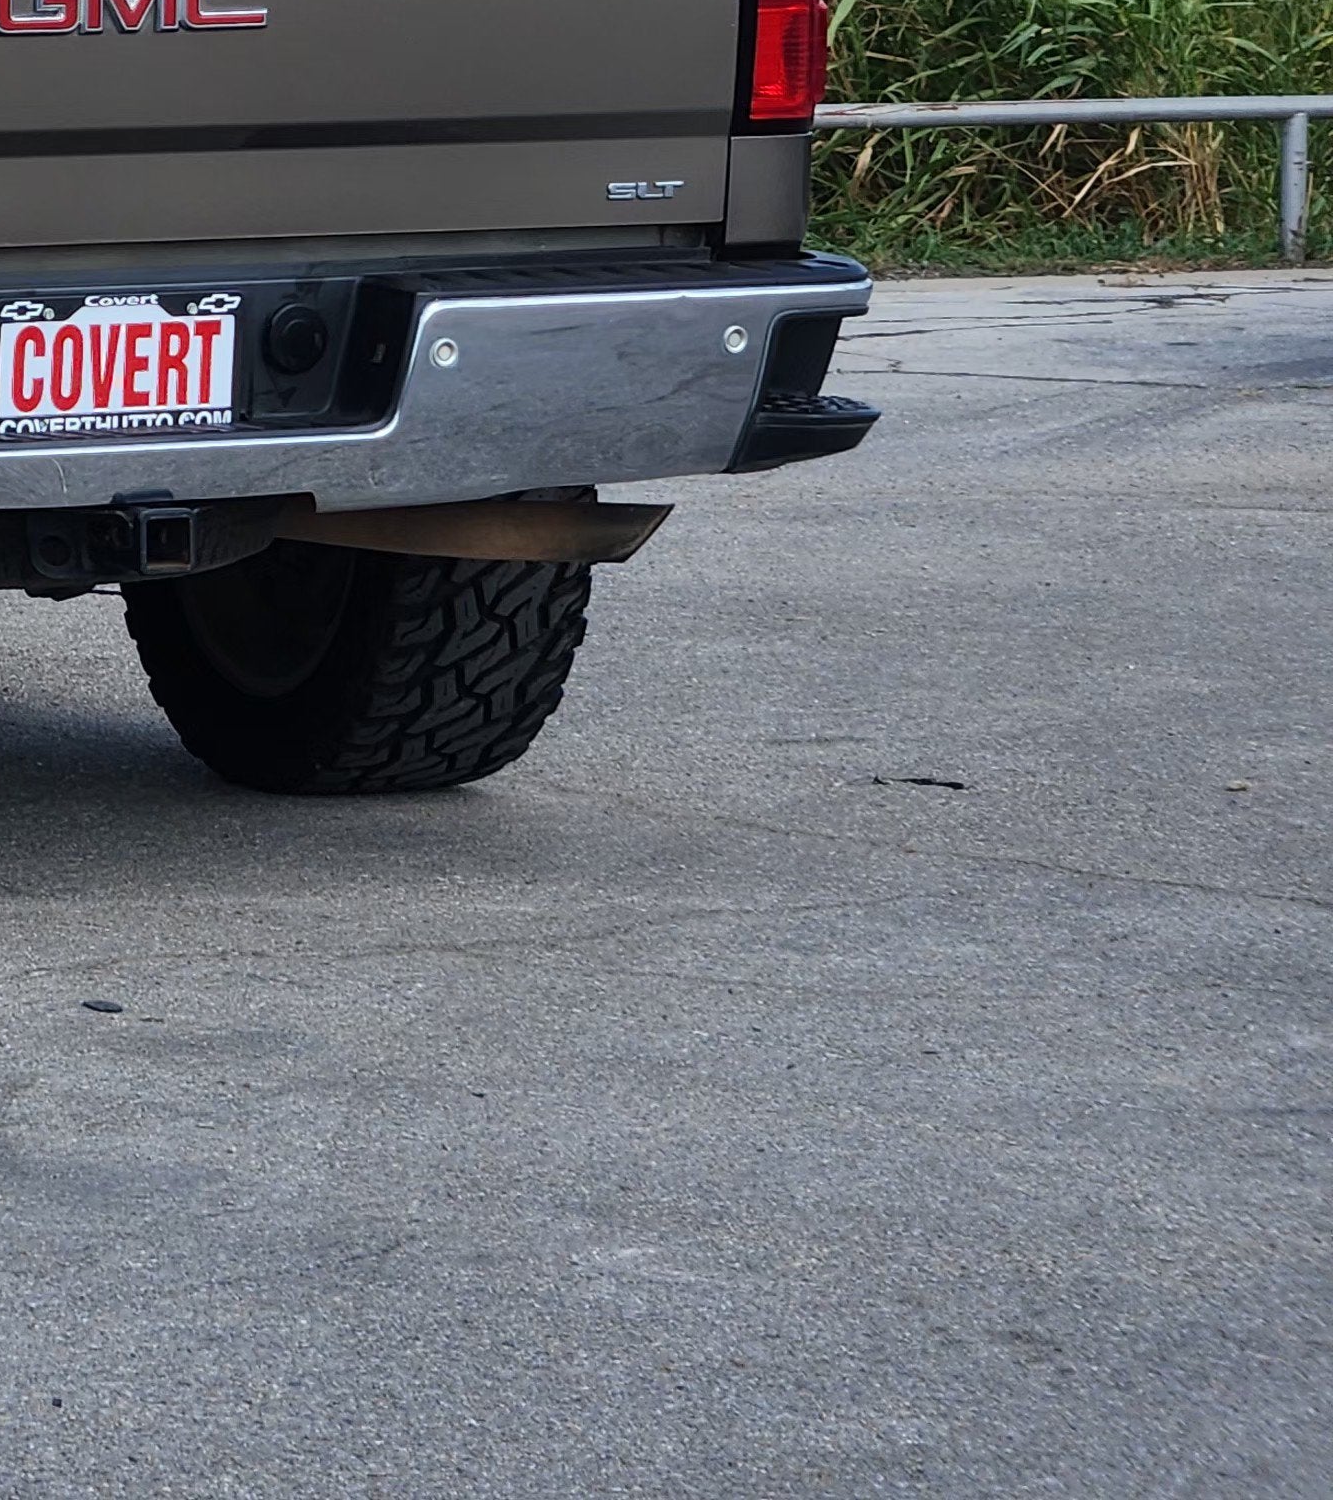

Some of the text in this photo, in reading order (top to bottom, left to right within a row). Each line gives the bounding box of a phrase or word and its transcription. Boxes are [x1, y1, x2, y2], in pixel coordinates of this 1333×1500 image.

[607, 181, 684, 200] SLT
[84, 294, 159, 307] Covert
[11, 319, 221, 412] COVERT
